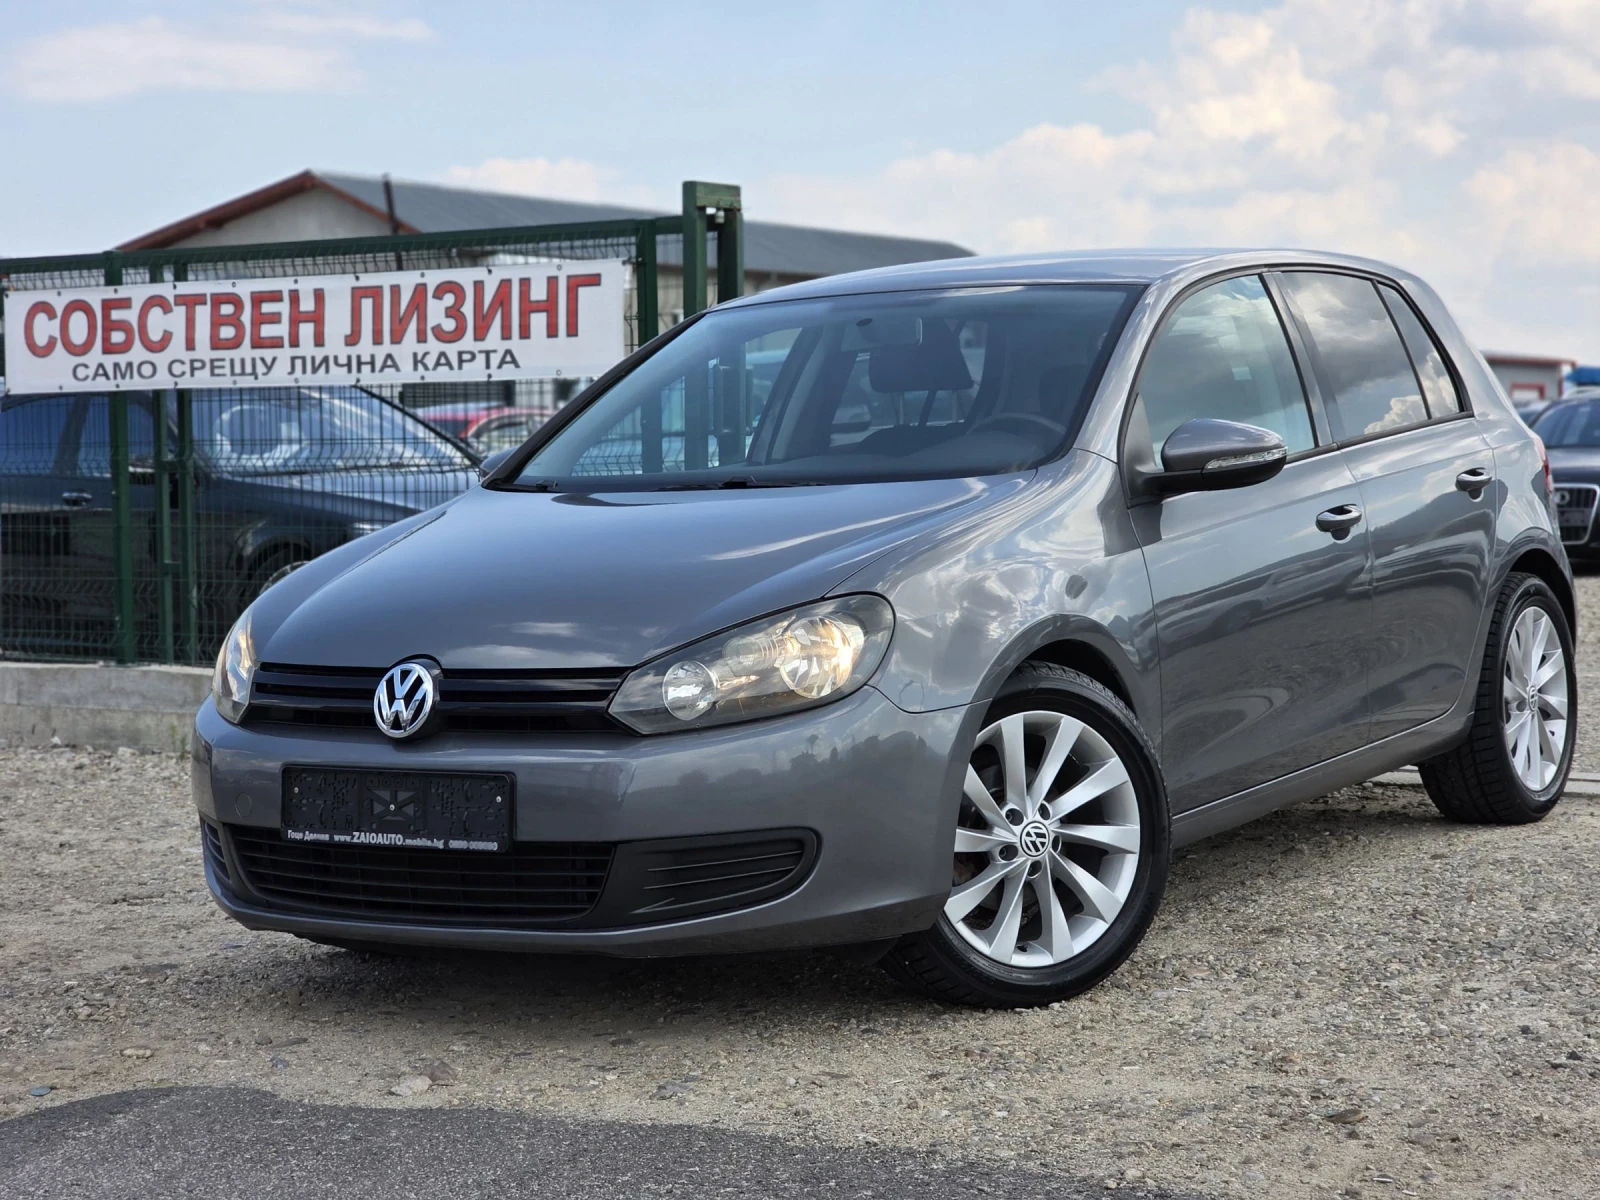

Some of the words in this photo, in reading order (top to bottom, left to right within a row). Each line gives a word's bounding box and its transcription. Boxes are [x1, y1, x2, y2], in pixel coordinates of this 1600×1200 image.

[23, 287, 326, 359] СОБСТВЕН
[344, 272, 602, 347] ЛИЗИНГ
[71, 360, 158, 382] САМО
[167, 355, 278, 380] СРЕЩУ
[287, 352, 401, 376] ЛИЧНА
[412, 348, 521, 372] КАРТА
